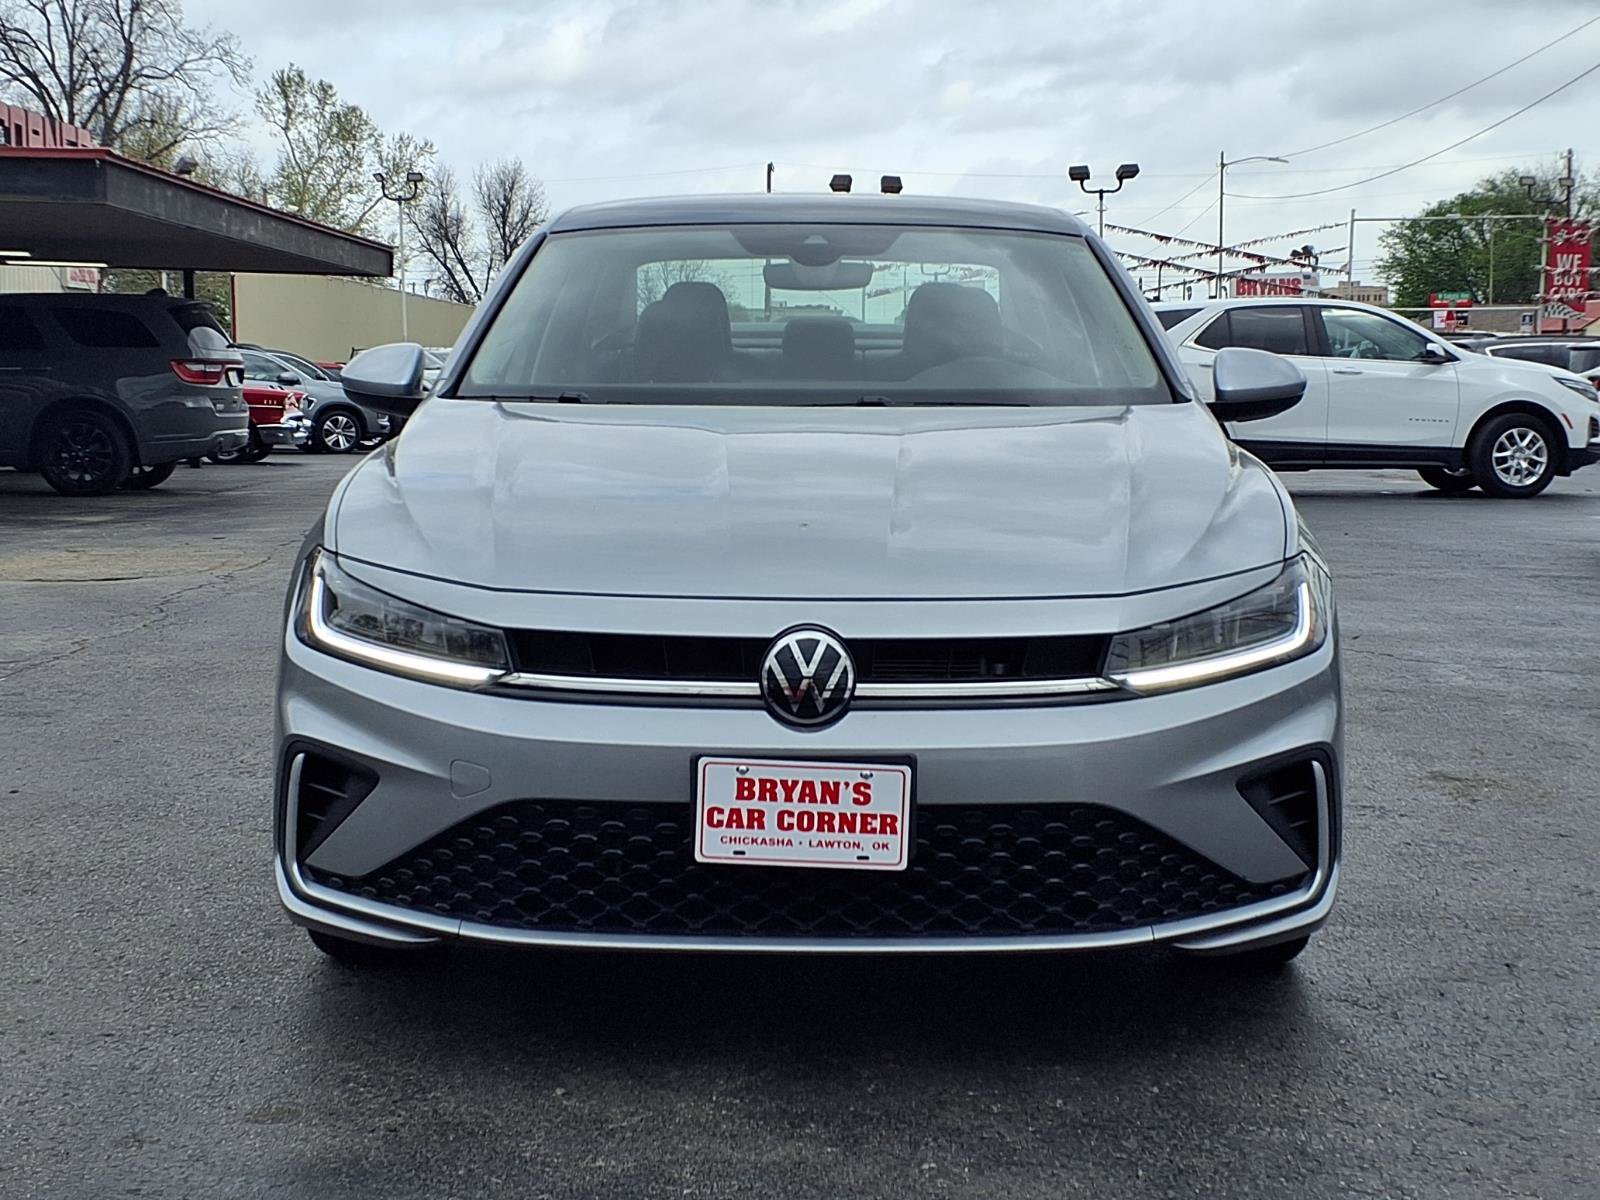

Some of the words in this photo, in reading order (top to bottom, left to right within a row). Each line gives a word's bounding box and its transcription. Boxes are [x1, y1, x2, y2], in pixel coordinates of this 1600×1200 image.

[1556, 253, 1583, 272] WE
[1553, 272, 1582, 286] BUY
[735, 777, 872, 806] BRYAN'S
[706, 806, 766, 831] CAR
[776, 809, 898, 836] CORNER
[720, 835, 794, 848] CHICKASHA
[808, 839, 864, 851] LAWTON,
[872, 841, 890, 850] OK
